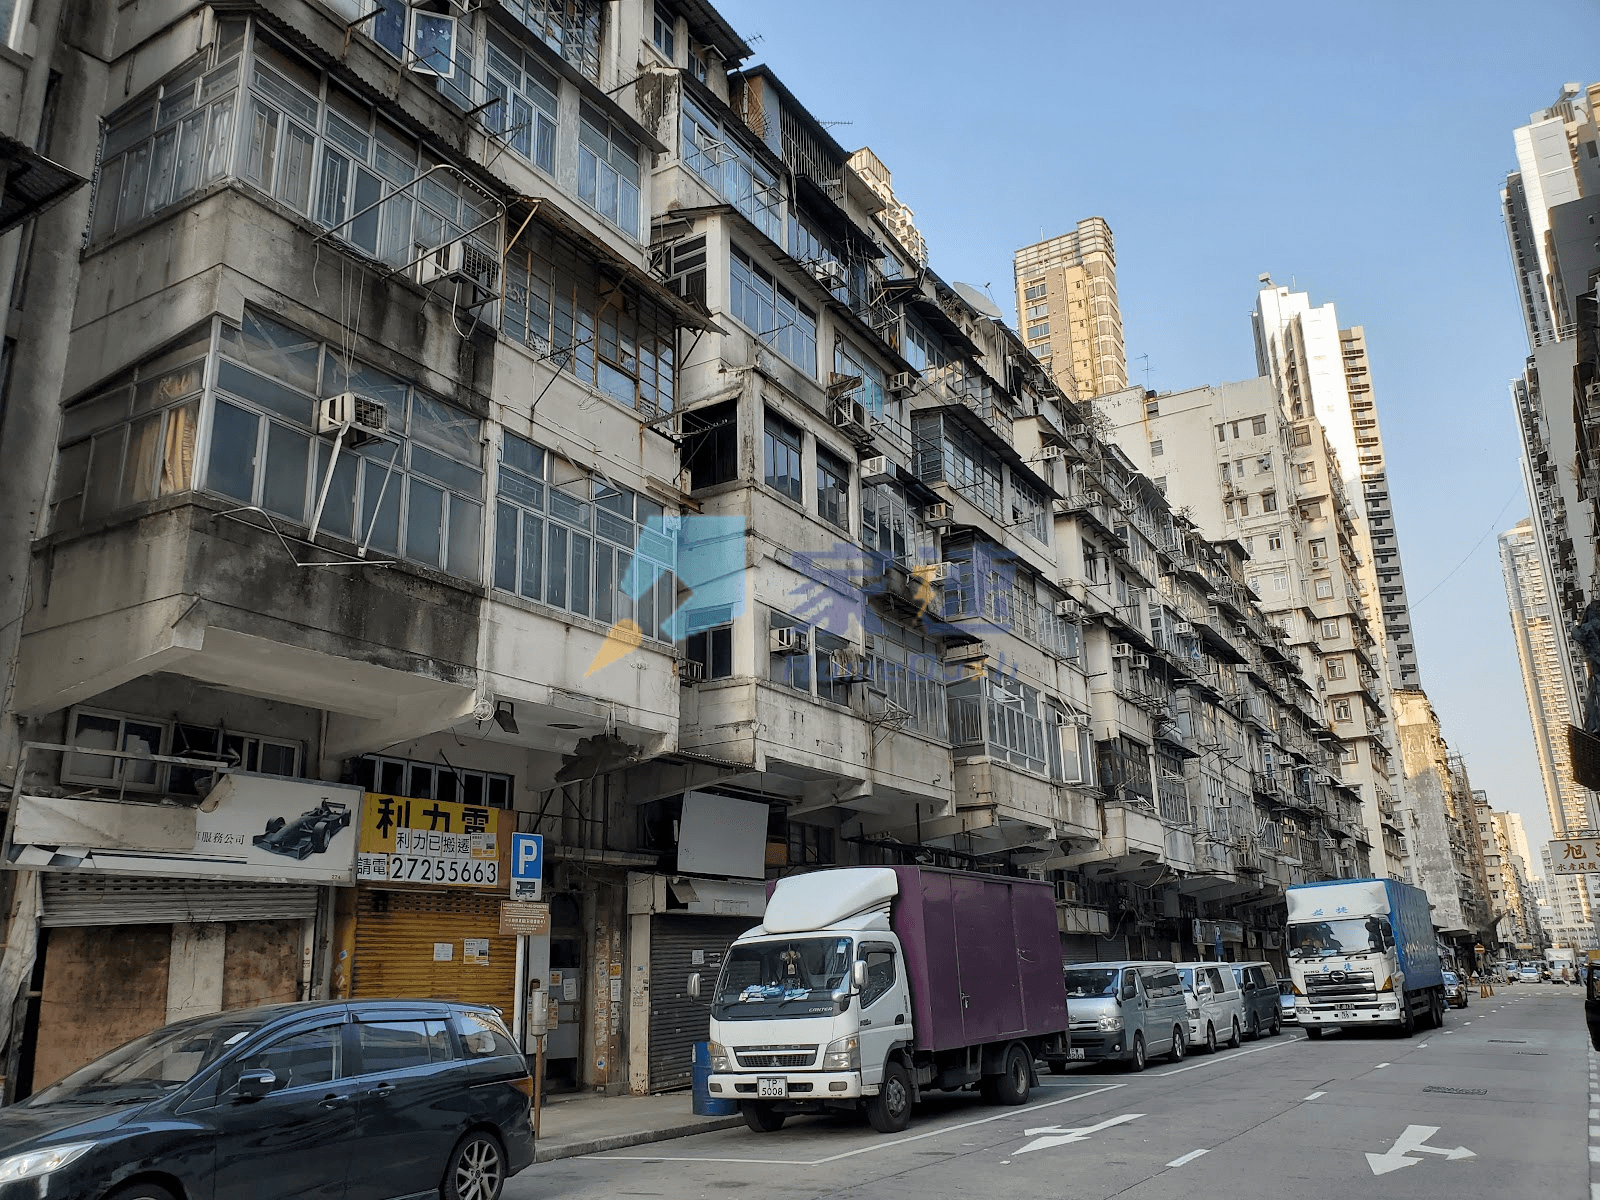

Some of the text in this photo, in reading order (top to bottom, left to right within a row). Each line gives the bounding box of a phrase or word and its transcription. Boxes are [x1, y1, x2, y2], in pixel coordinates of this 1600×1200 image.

[396, 831, 471, 855] 利力已搬遷
[518, 838, 538, 875] P
[391, 857, 498, 884] 27255663
[761, 1087, 783, 1096] 5008
